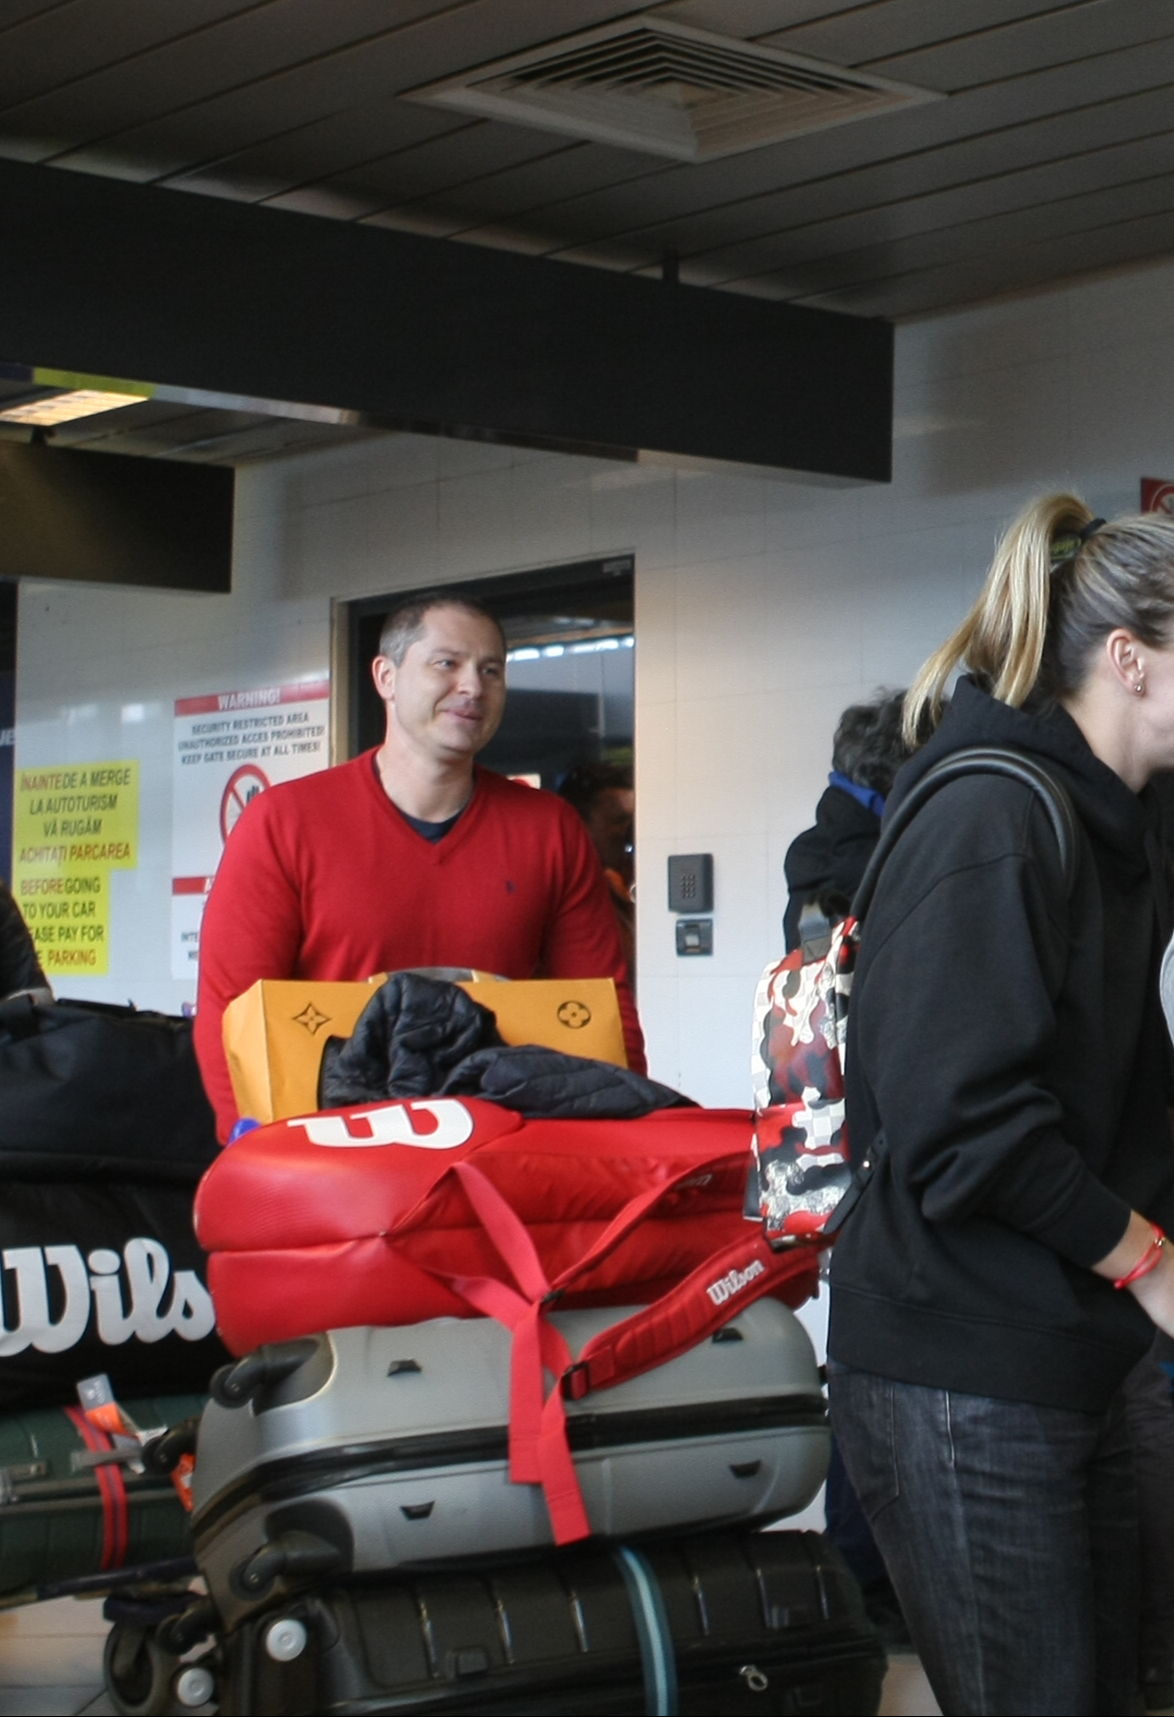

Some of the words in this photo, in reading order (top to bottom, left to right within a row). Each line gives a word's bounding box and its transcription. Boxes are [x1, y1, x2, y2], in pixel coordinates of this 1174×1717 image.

[218, 687, 281, 711] WARNING!
[191, 720, 232, 736] SECURITY
[232, 715, 285, 731] RESTRICTED
[286, 712, 309, 724] AREA
[178, 734, 240, 752] UNAUTHORIZED
[181, 753, 202, 765] KEEP
[203, 751, 224, 764] GATE
[226, 748, 259, 762] SECURE
[260, 746, 271, 757] AT
[273, 744, 289, 756] ALL
[291, 740, 321, 754] TIMES!
[62, 772, 78, 789] DE
[79, 771, 88, 788] A
[89, 768, 132, 787] MERGE
[29, 798, 44, 815] LA
[45, 794, 118, 814] AUTOTURISM
[68, 842, 131, 862] PARCAREA
[21, 878, 64, 896] BEFORE
[64, 876, 101, 894] GOING
[22, 902, 37, 919] TO
[38, 901, 69, 919] YOUR
[71, 900, 96, 918] CAR
[58, 925, 79, 943] PAY
[80, 924, 105, 943] FOR
[48, 948, 98, 967] PARKING
[706, 1259, 766, 1306] Wilson
